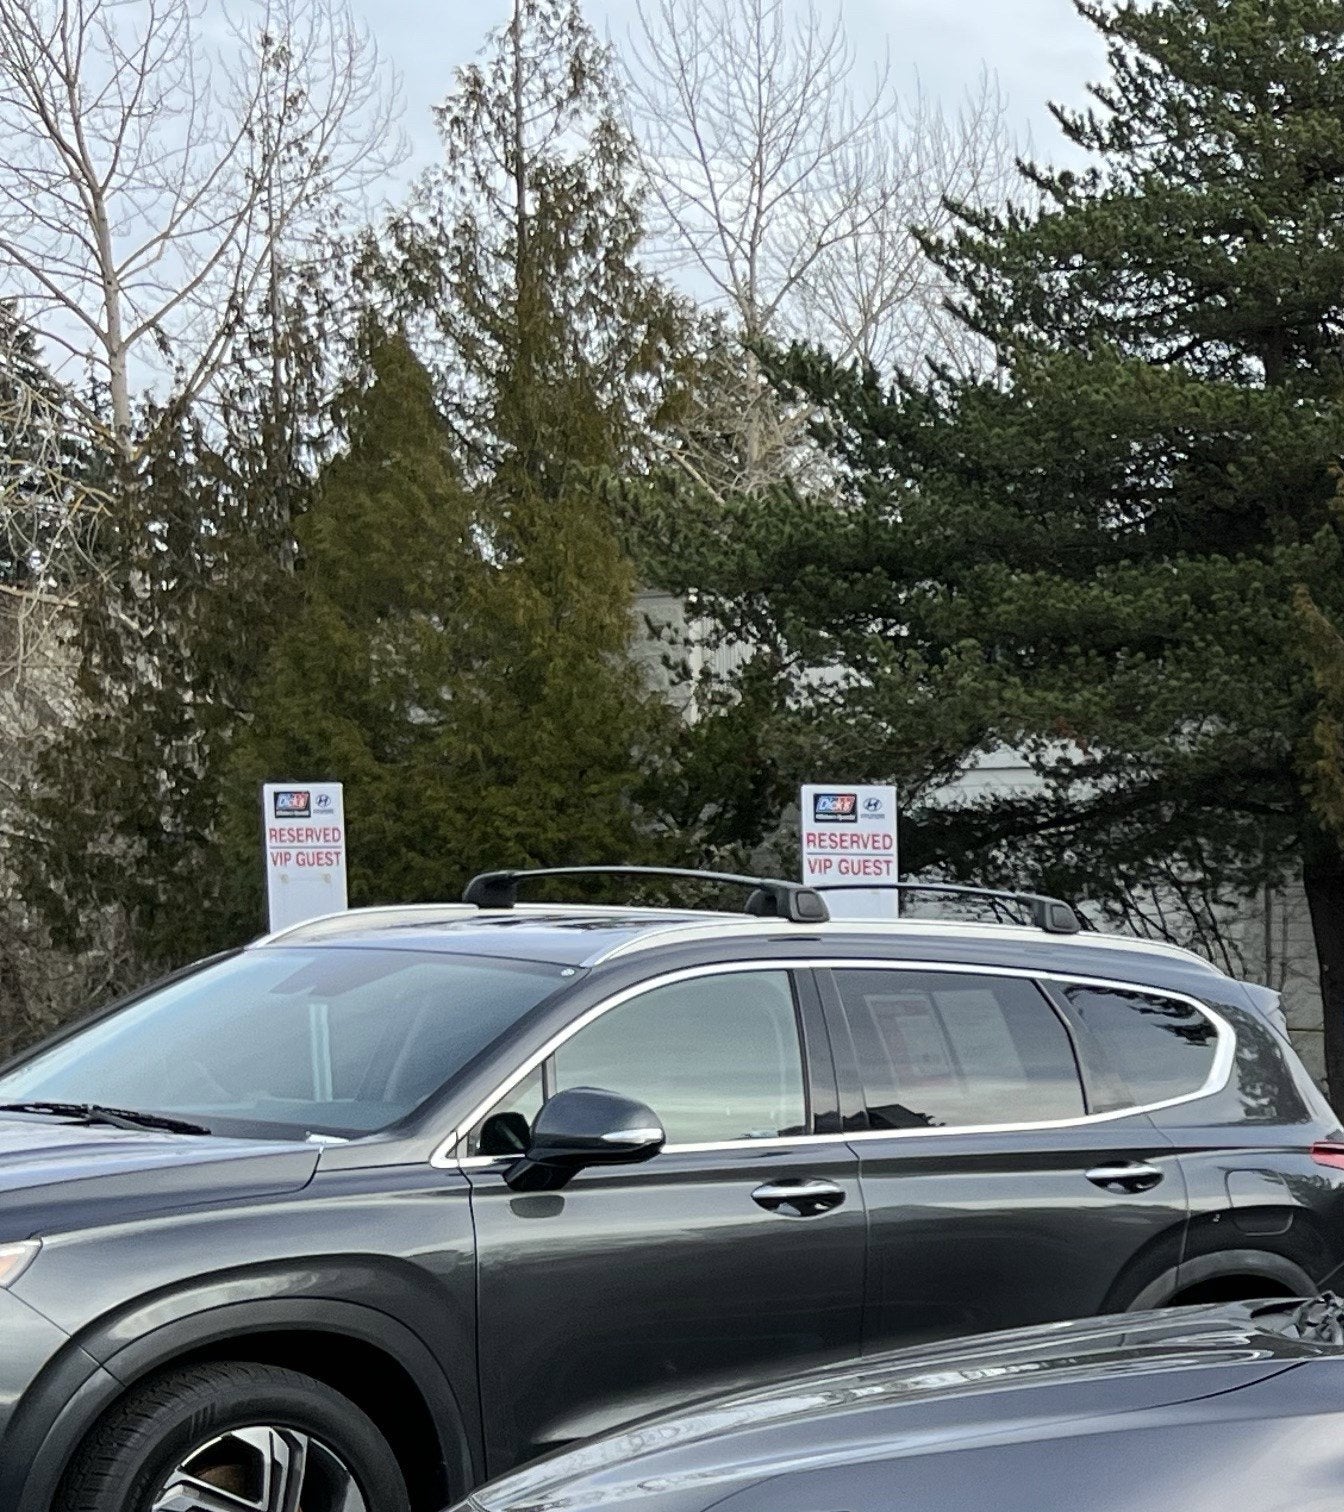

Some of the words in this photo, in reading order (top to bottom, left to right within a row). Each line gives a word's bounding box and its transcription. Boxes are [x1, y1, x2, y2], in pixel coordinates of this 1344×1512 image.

[268, 826, 342, 844] RESERVED
[806, 831, 894, 851] RESERVED
[270, 851, 292, 867] VIP
[295, 851, 342, 868] GUEST
[807, 857, 833, 875] VIP
[837, 858, 893, 877] GUEST
